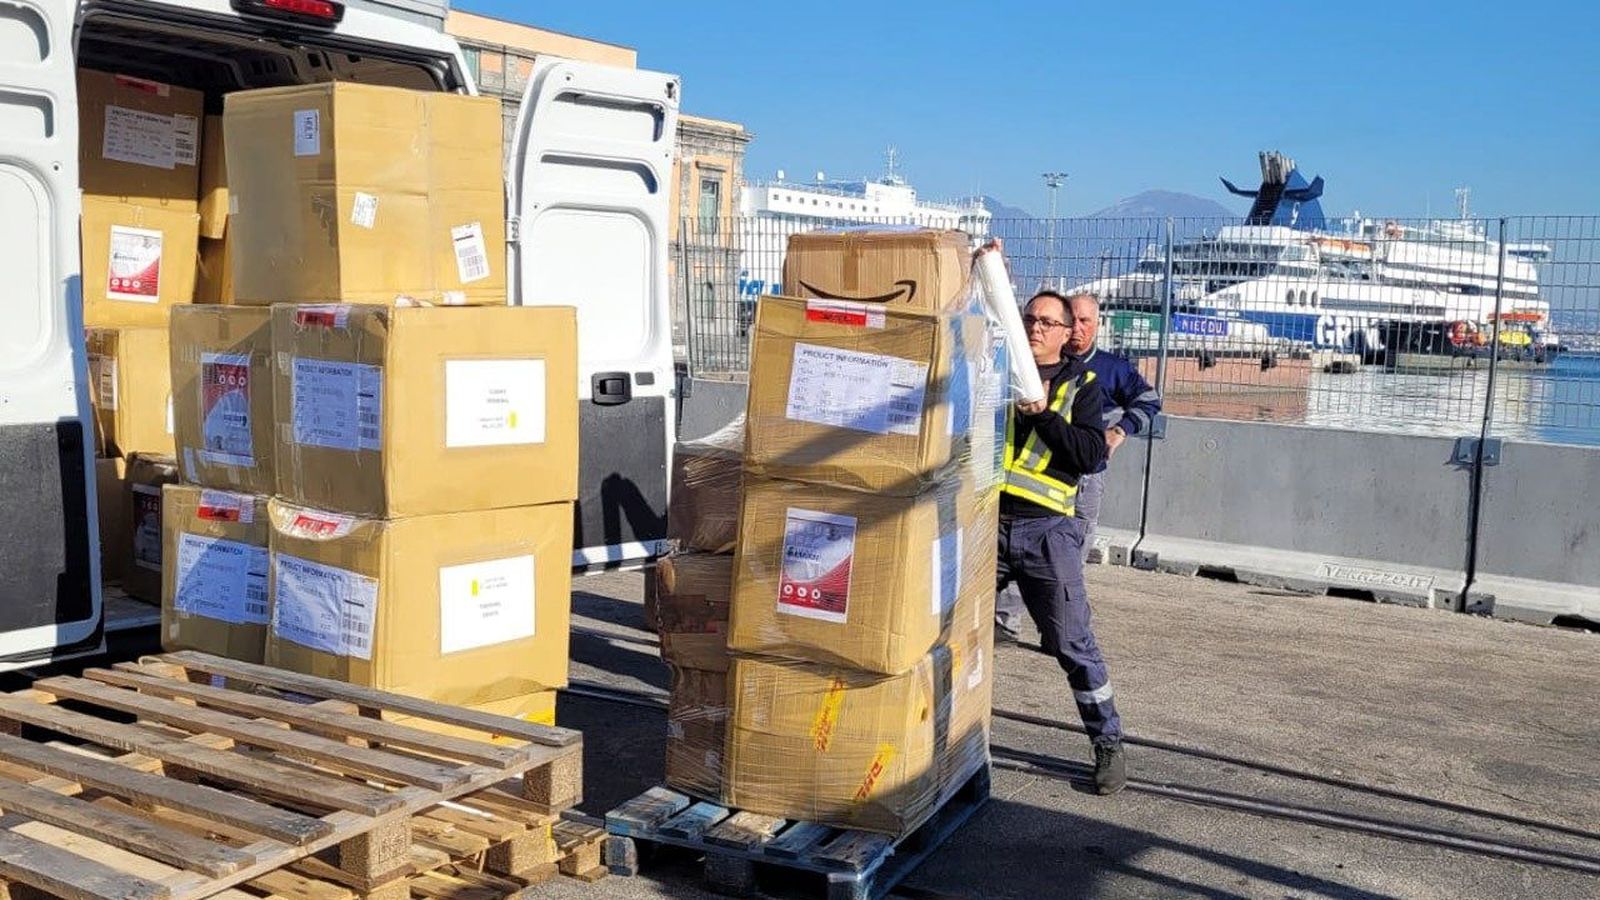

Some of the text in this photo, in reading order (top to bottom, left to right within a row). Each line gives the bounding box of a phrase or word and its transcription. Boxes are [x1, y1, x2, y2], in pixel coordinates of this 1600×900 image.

[802, 350, 890, 369] PRODUCT INFORMATION
[855, 761, 883, 800] DHL
